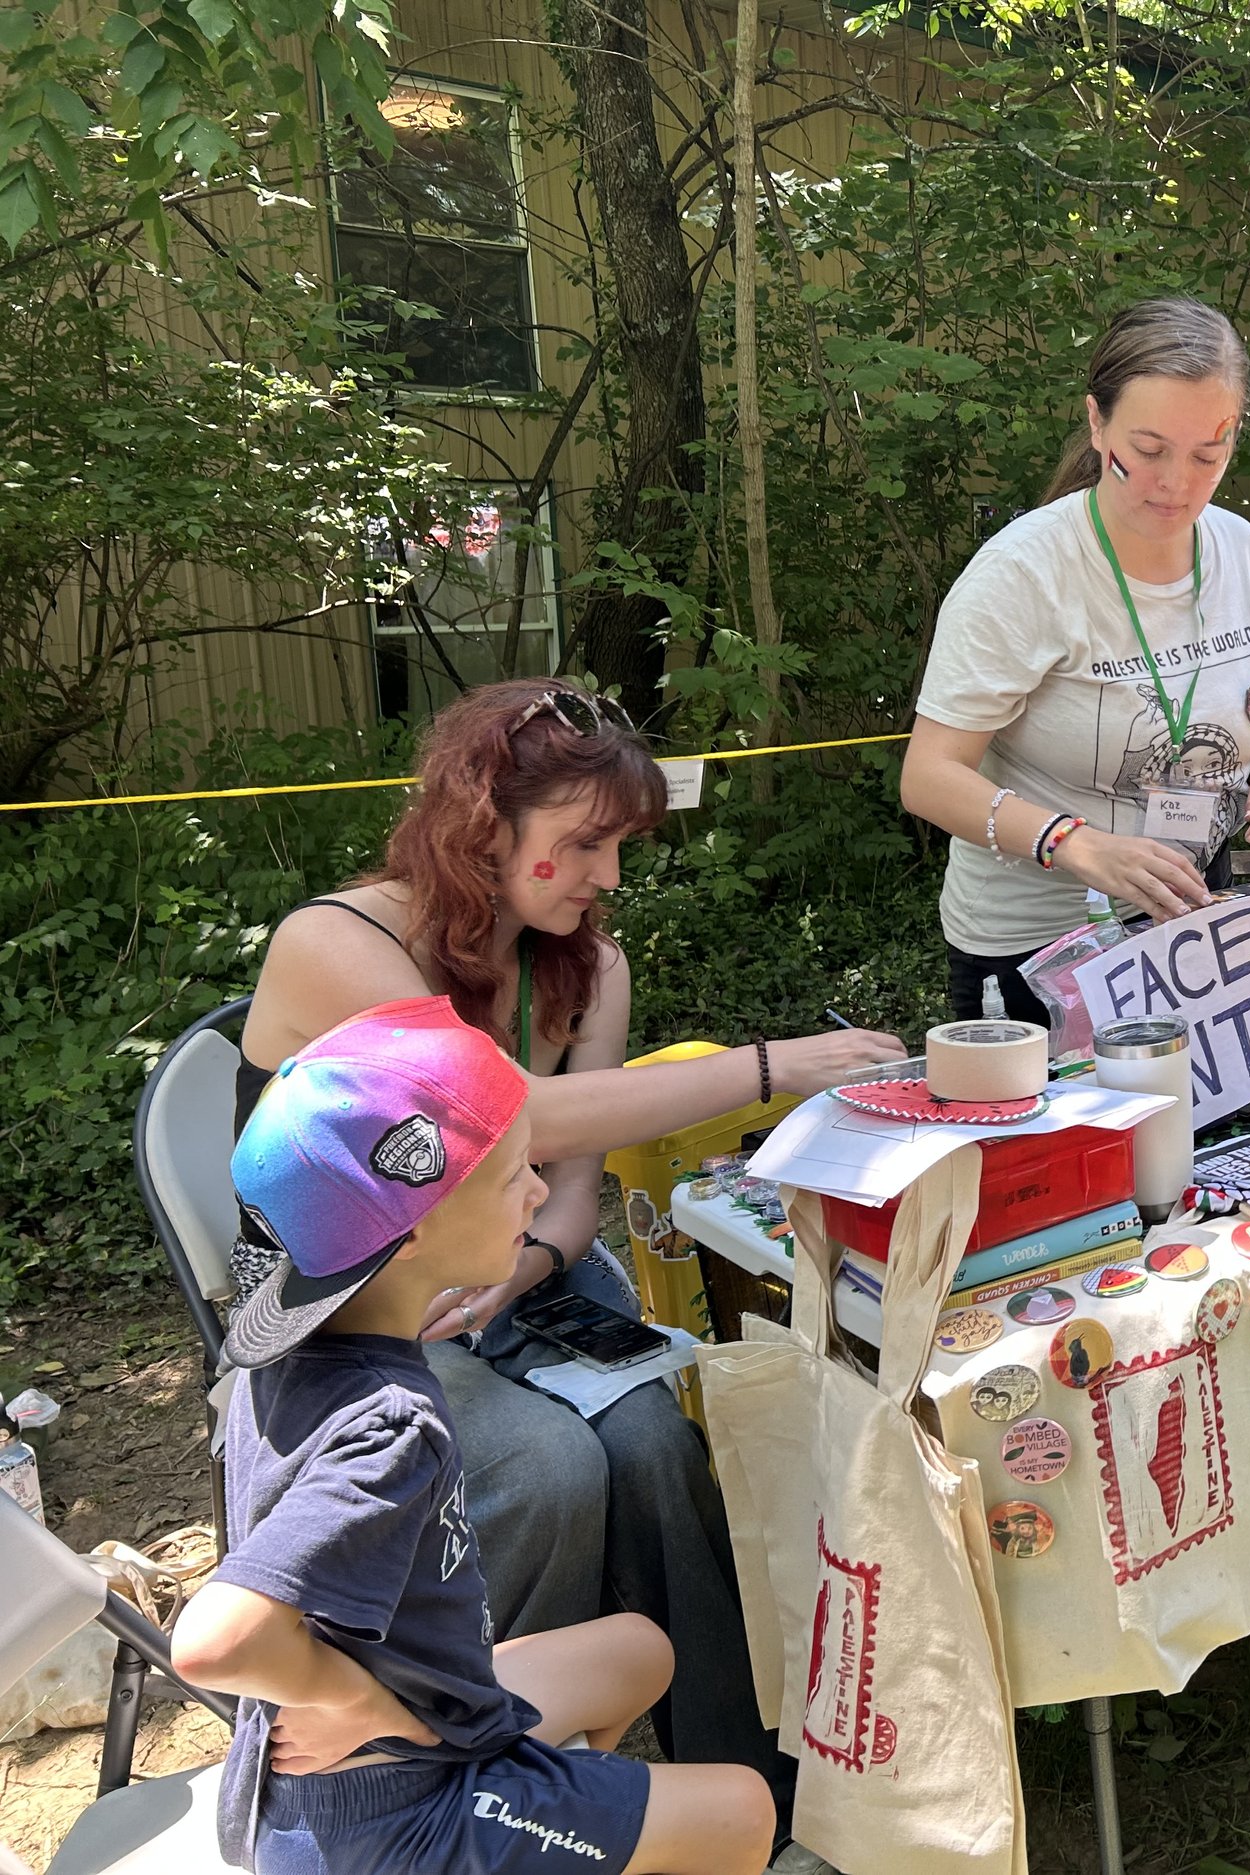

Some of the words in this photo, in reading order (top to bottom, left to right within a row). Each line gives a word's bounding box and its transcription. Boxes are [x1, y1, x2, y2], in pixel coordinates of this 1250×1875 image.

[1166, 648, 1181, 667] IS
[1183, 640, 1210, 661] THE
[1160, 800, 1180, 810] Kaz
[1206, 1160, 1250, 1177] TIES
[1012, 1275, 1051, 1292] CHICKEN
[977, 1285, 1010, 1302] SQUAD
[1013, 1425, 1034, 1434] EVERY
[1197, 1362, 1220, 1508] PALESTINE
[1026, 1439, 1067, 1451] VILLAGE
[1011, 1461, 1065, 1474] HOMETOWN
[834, 1587, 857, 1738] PALESTINE
[471, 1791, 607, 1861] Champion
